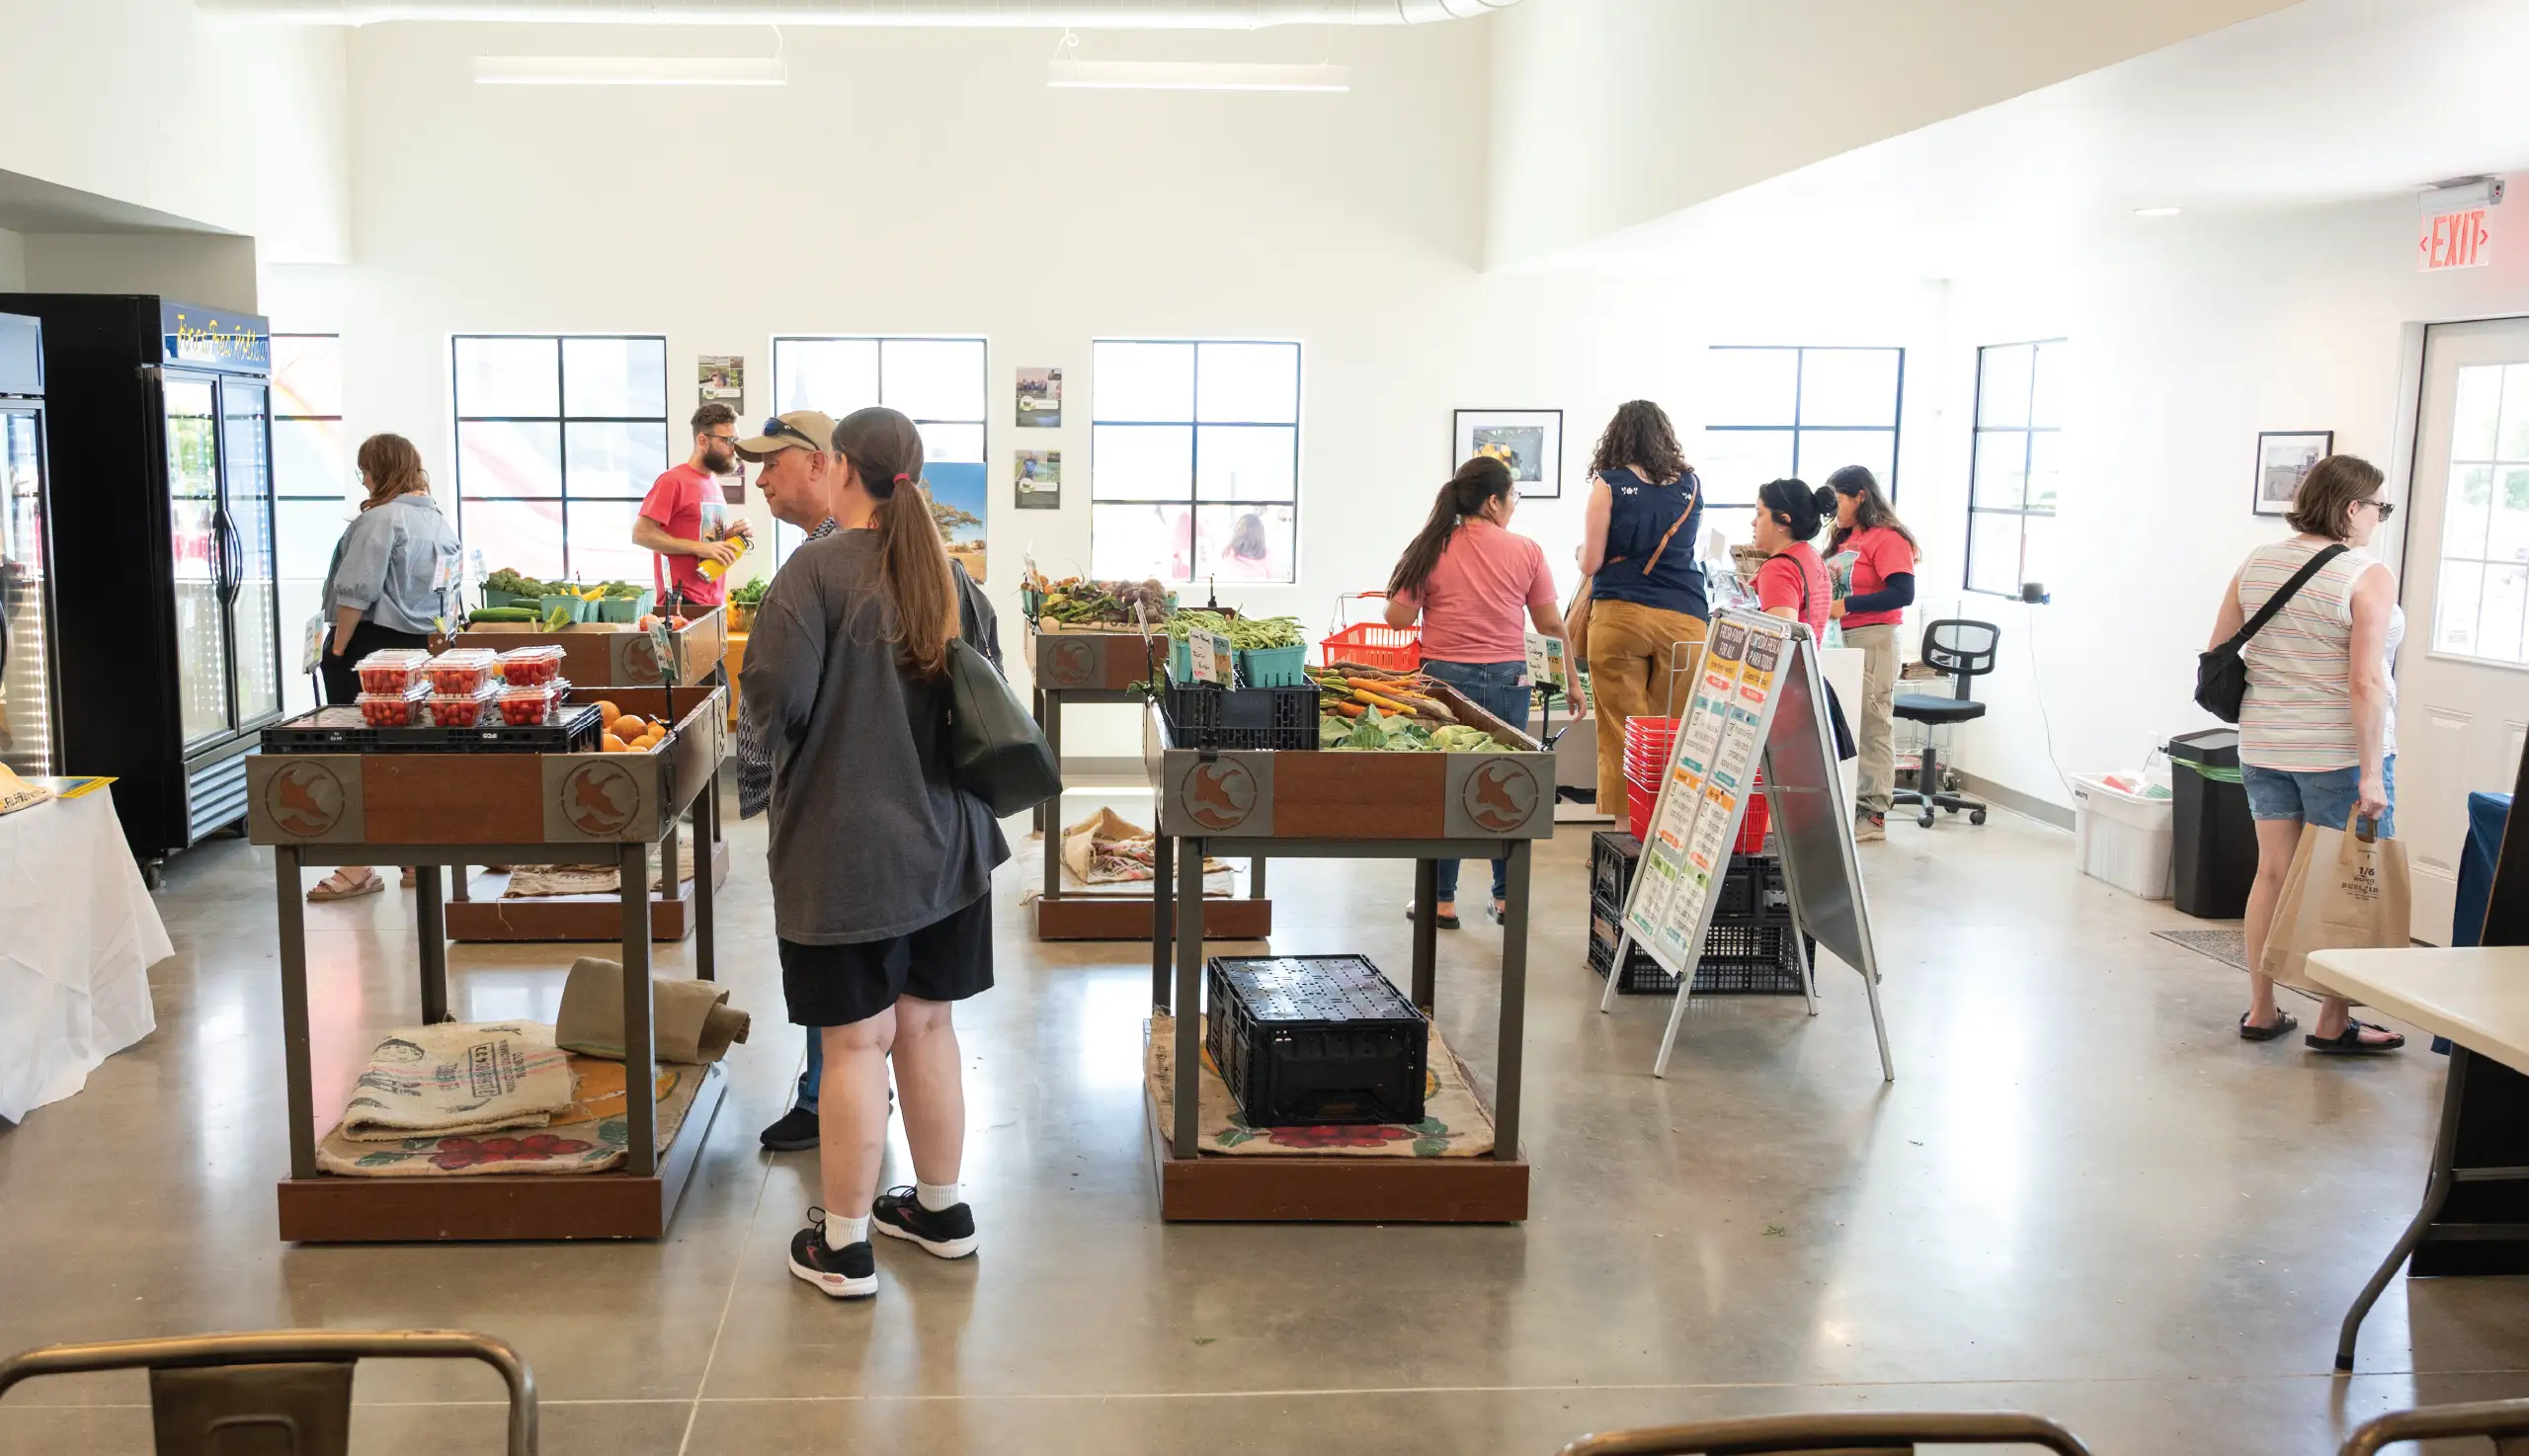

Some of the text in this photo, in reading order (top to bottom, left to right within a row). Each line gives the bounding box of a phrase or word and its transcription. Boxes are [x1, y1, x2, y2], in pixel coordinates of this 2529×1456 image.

[2429, 210, 2485, 268] EXIT
[1719, 624, 1745, 644] FRESH FOOD
[1718, 641, 1736, 659] FOR ALL
[1748, 649, 1774, 672] PARA TODOS
[2358, 866, 2376, 876] 1/6
